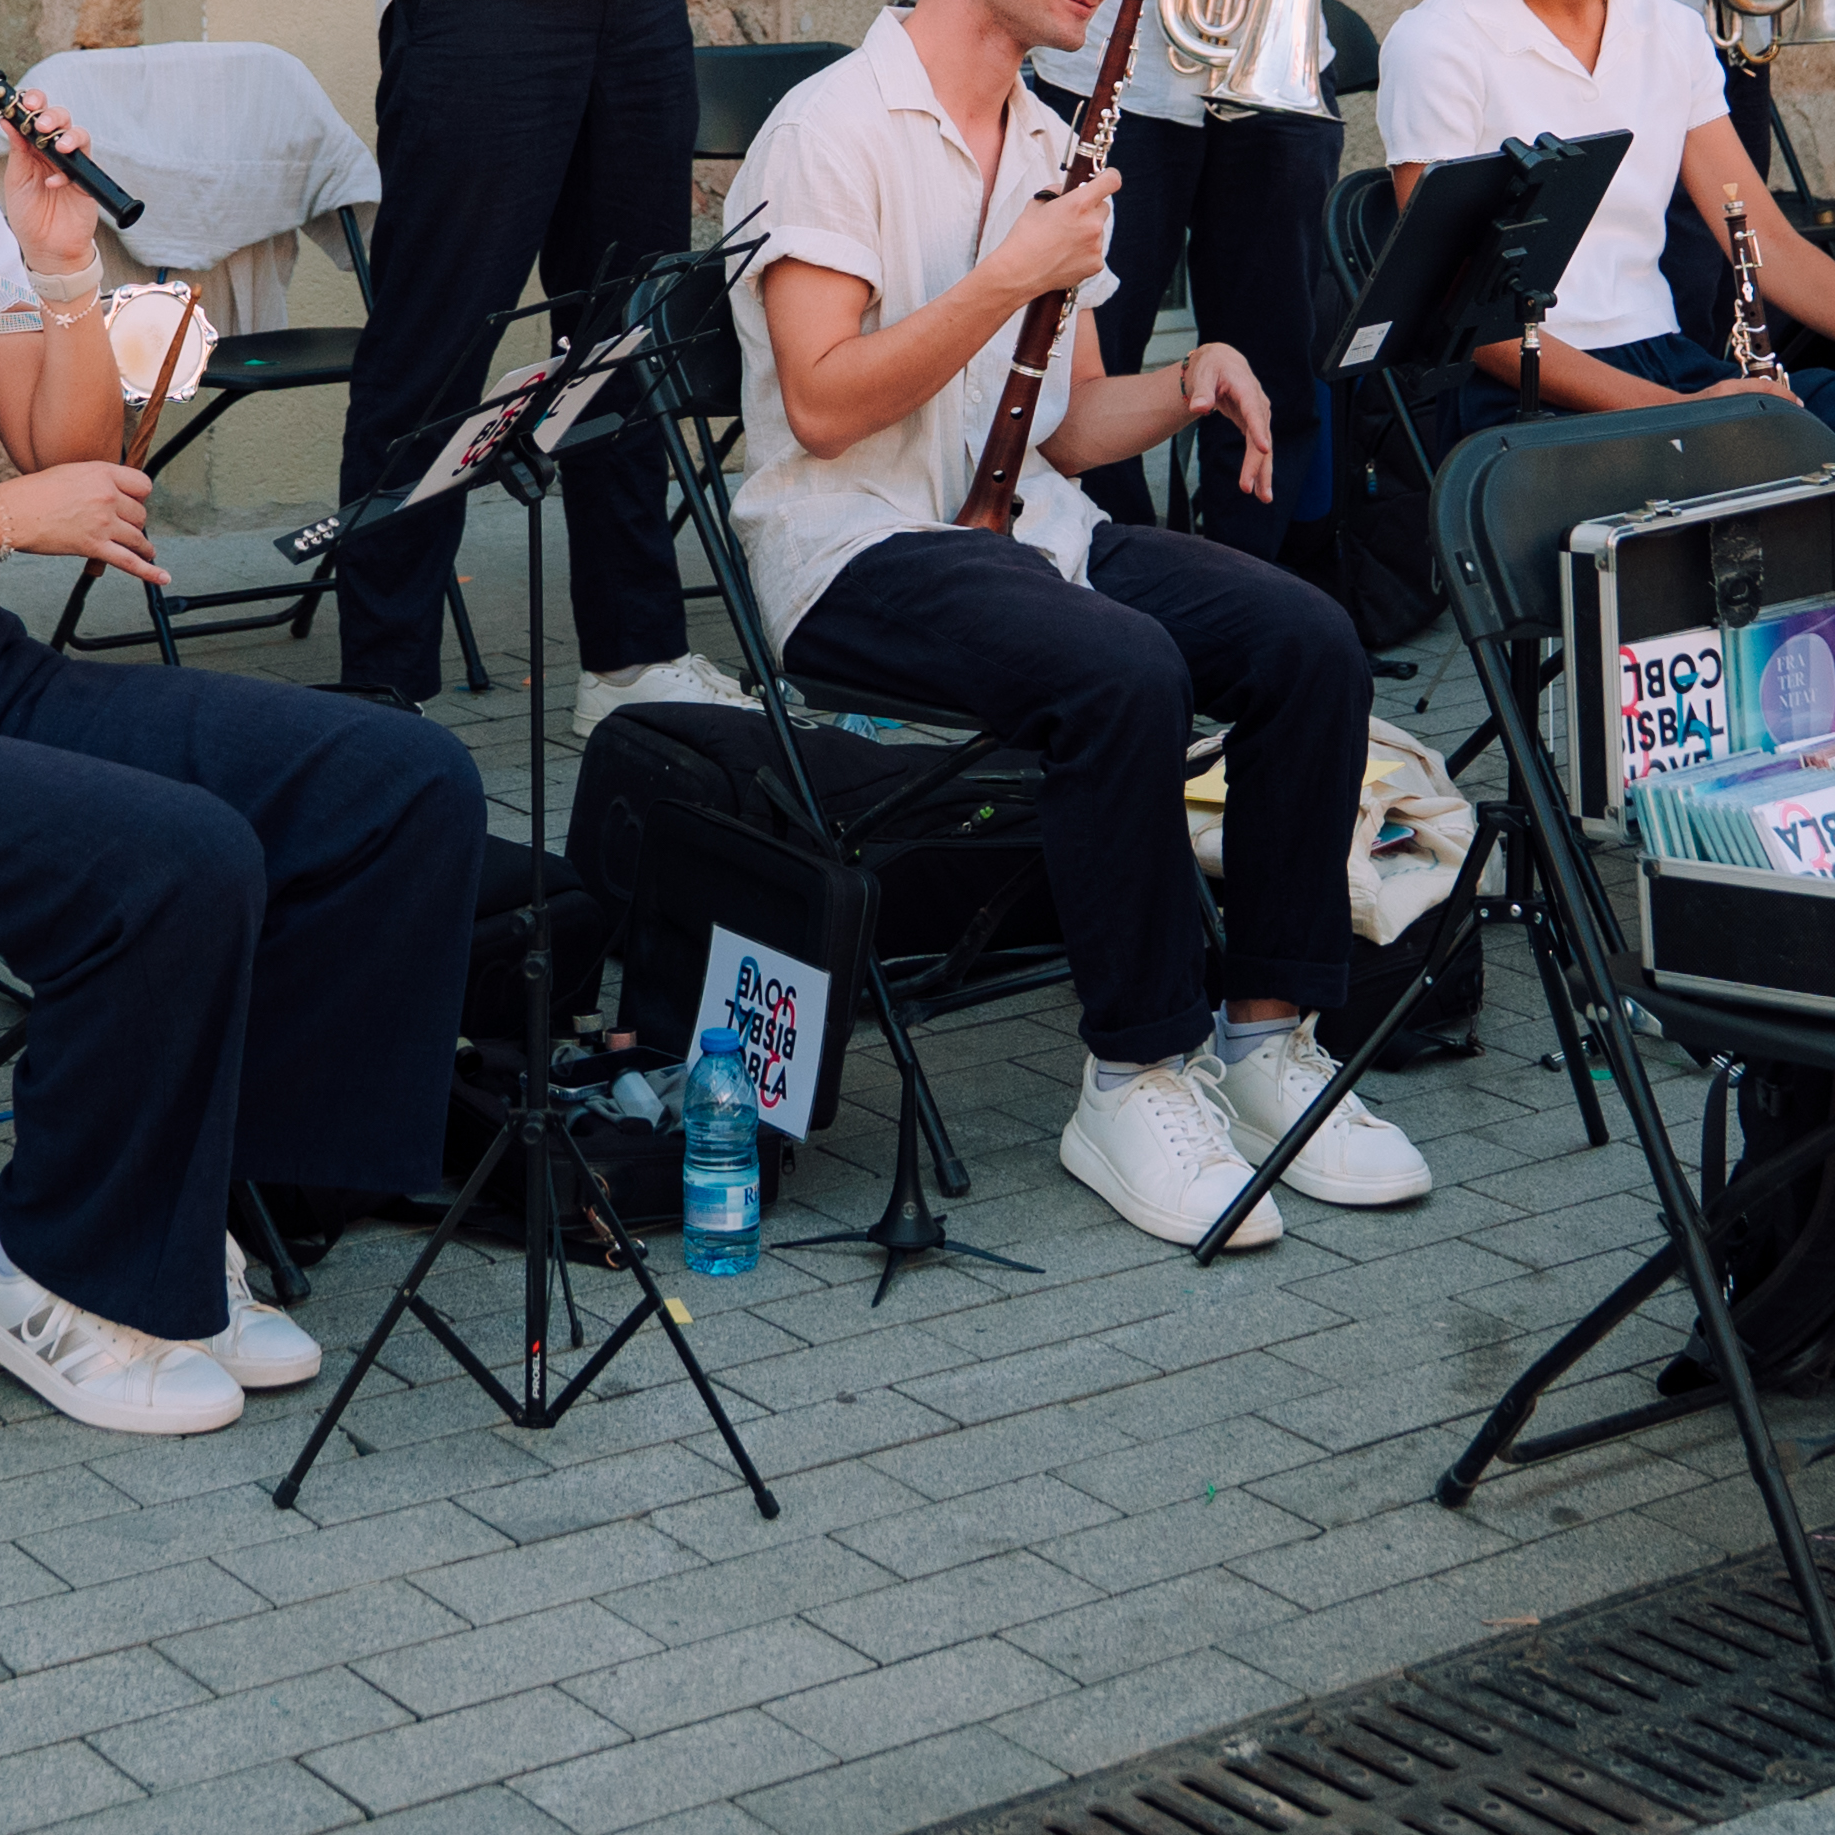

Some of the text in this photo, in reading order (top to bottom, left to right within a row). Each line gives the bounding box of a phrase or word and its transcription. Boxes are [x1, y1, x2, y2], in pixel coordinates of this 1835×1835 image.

[1624, 648, 1723, 702] COBL
[1776, 653, 1805, 672] FRA
[1778, 672, 1805, 690] TER
[1779, 689, 1817, 709] NITAT
[1621, 698, 1724, 754] ISBAL
[737, 966, 798, 1017] JOVE
[724, 997, 798, 1061] BISBAL
[531, 1352, 541, 1399] PROEL
